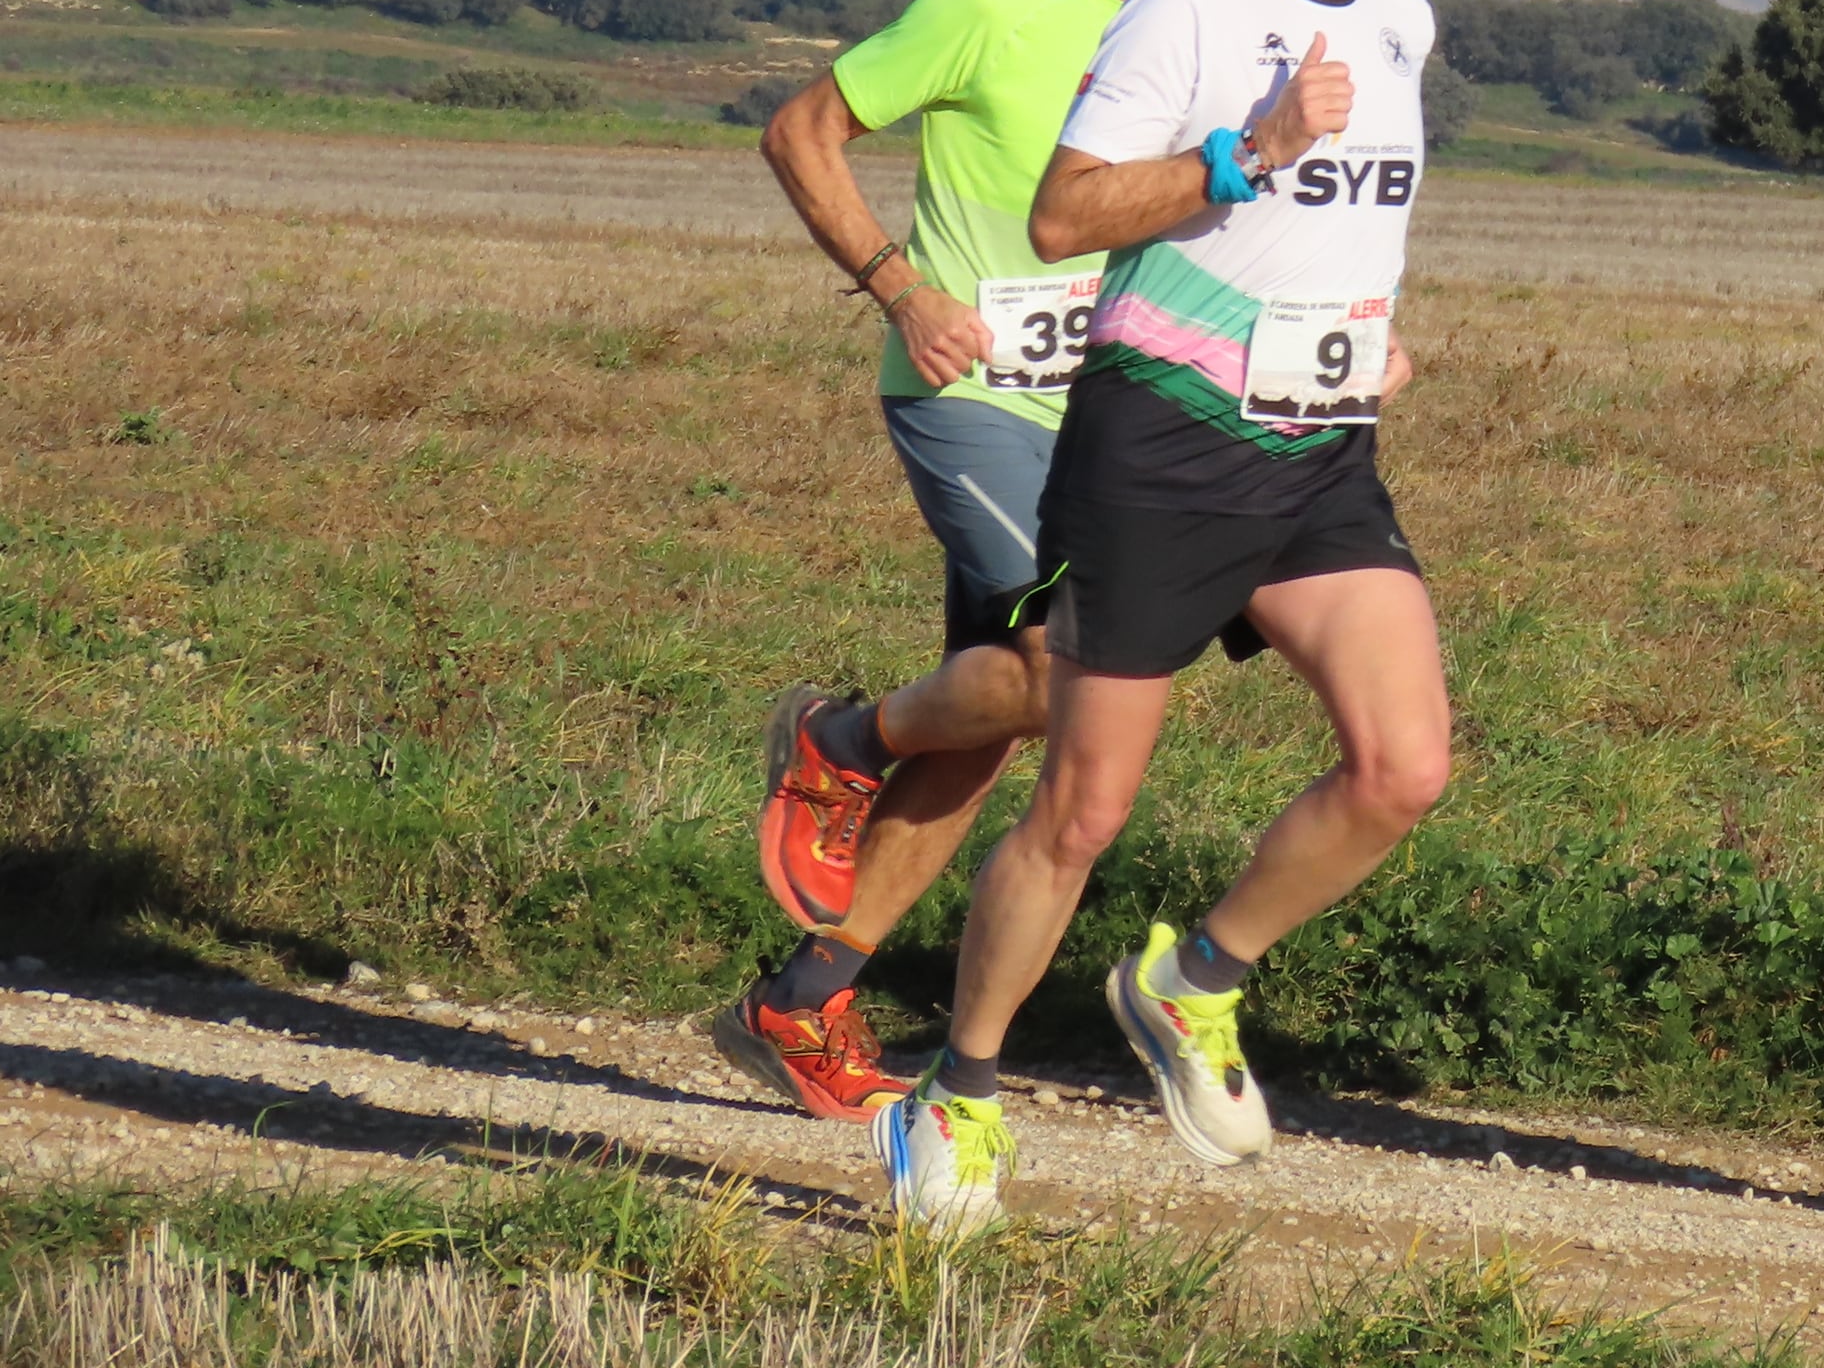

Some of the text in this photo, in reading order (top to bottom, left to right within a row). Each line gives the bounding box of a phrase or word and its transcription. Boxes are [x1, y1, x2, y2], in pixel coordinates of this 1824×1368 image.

[1293, 159, 1414, 206] SYB
[1020, 306, 1095, 363] 39
[1315, 331, 1352, 389] 9
